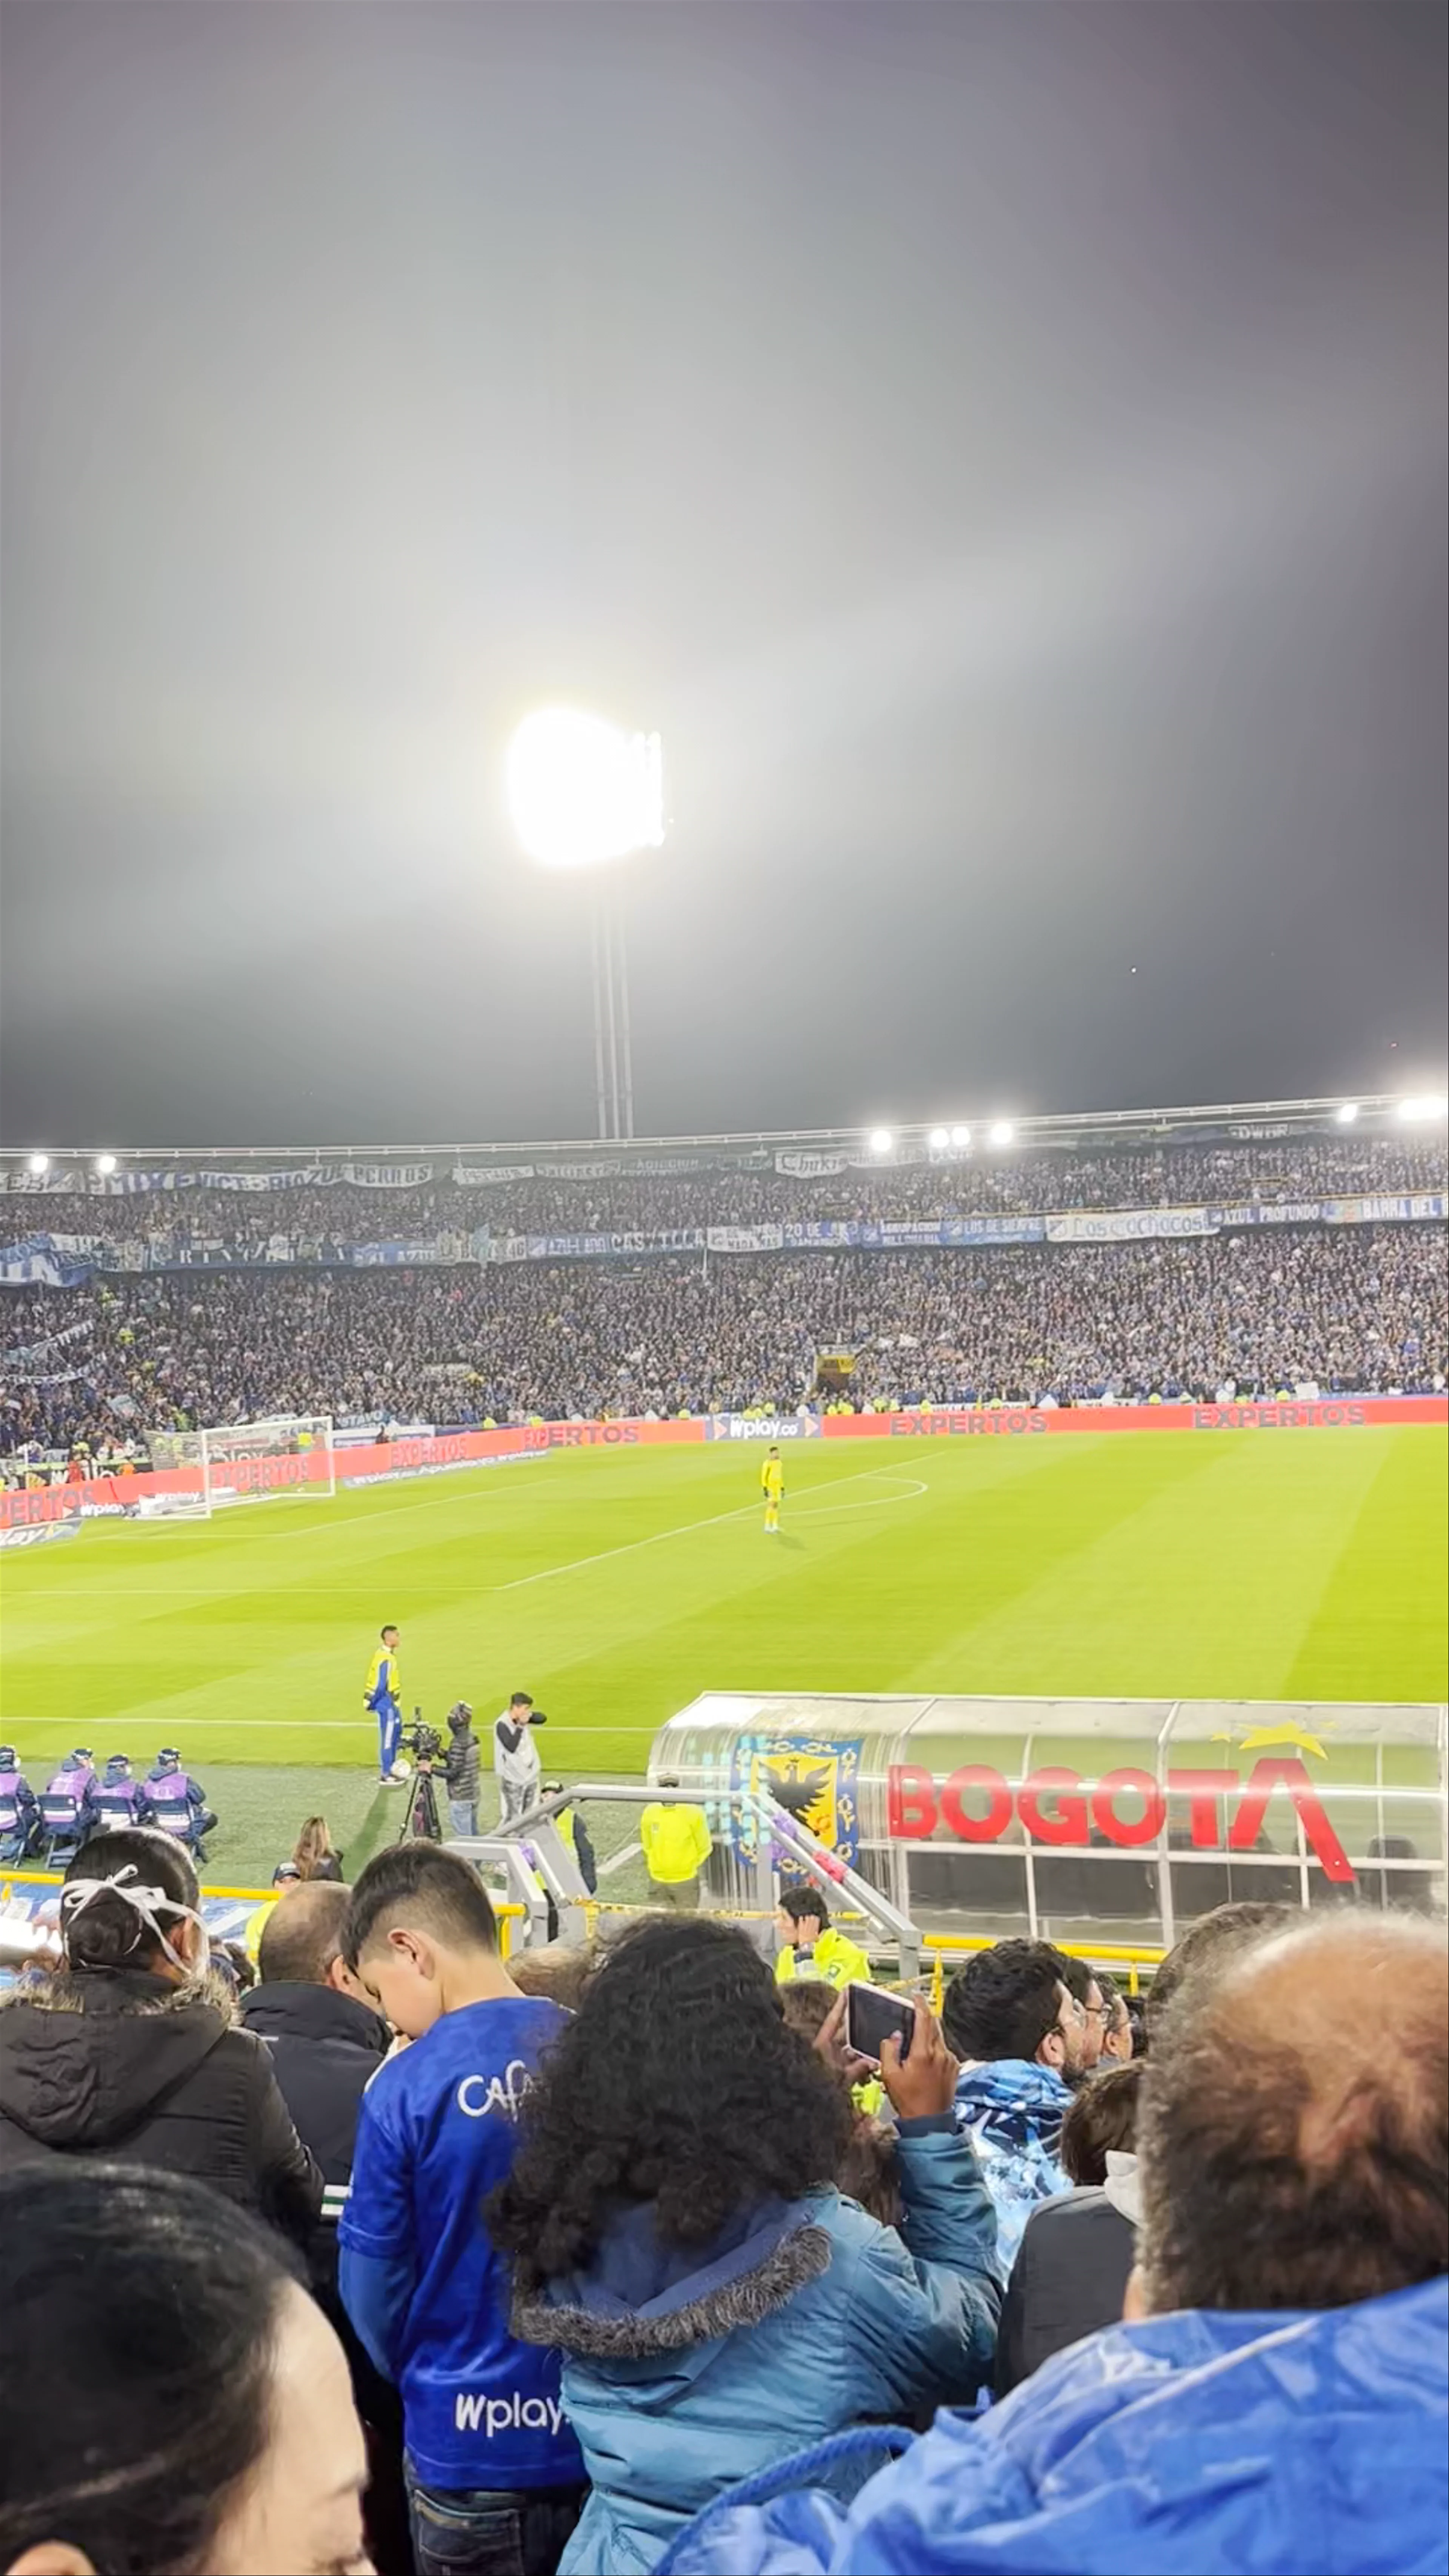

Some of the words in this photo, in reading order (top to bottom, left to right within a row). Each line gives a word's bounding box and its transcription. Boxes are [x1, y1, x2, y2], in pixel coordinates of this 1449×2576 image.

[1224, 1207, 1255, 1225] AZUL
[1259, 1204, 1320, 1223] PROFUNDO
[1363, 1199, 1409, 1217] BARRA
[1412, 1198, 1438, 1216] DEL
[891, 1412, 1048, 1436] EXPERTOS
[1193, 1405, 1365, 1429] EXPERTOS
[391, 1437, 467, 1469] EXPERTOS
